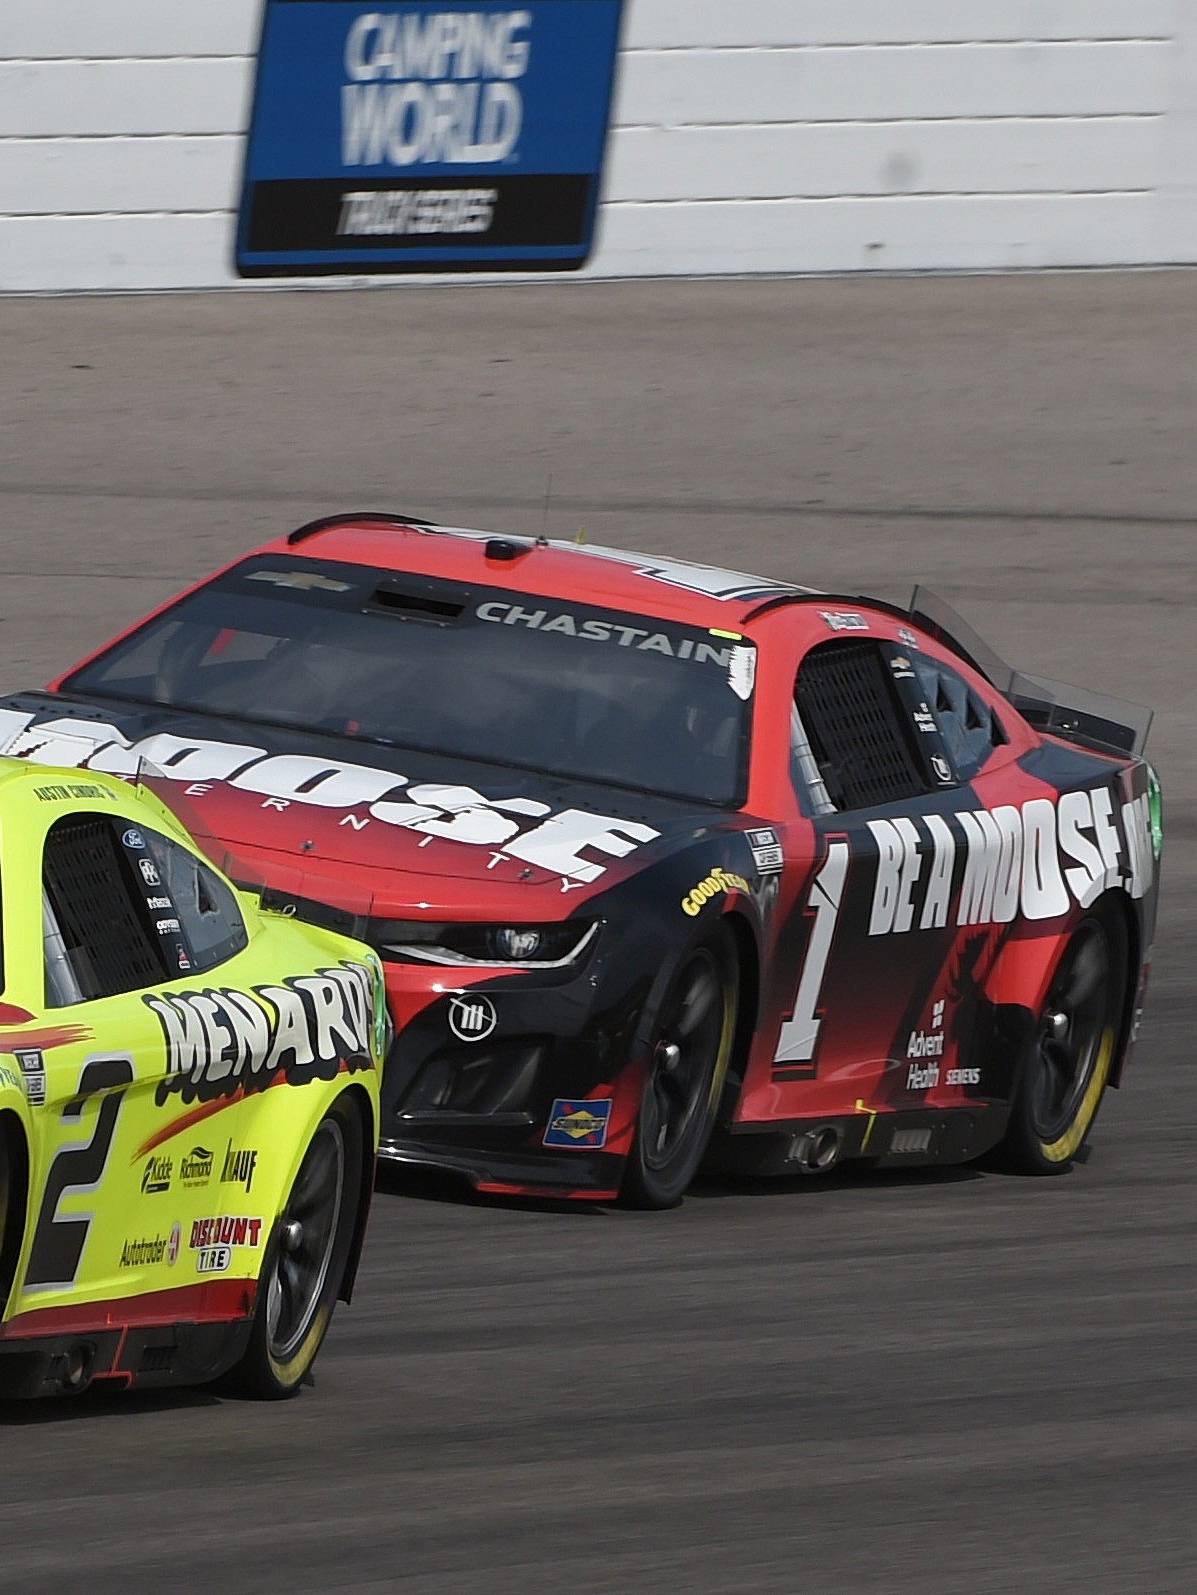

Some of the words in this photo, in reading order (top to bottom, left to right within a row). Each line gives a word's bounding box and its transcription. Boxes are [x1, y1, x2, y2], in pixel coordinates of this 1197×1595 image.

[344, 9, 532, 81] CAMPING
[340, 82, 523, 167] WORLD
[475, 602, 734, 668] CHASTAIN
[866, 817, 923, 936] BE
[919, 814, 956, 930] A
[774, 842, 849, 1063] 1
[22, 1052, 134, 1294] 2
[189, 1217, 262, 1249] DISCOUNT
[198, 1250, 226, 1270] TIRE
